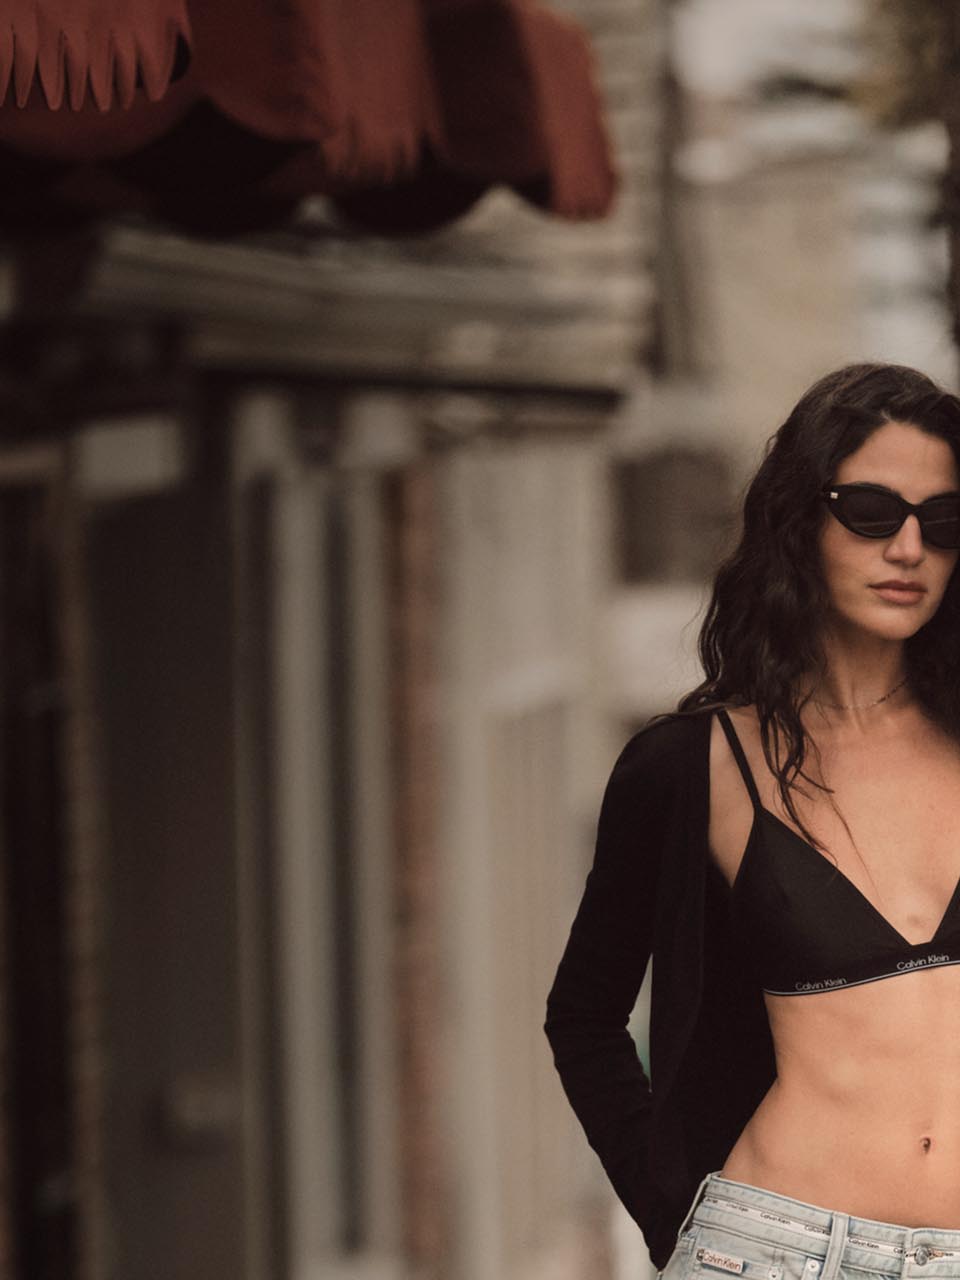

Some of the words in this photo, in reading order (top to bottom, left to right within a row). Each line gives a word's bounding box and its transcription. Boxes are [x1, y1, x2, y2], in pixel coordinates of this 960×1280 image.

[896, 958, 927, 970] Calvin
[927, 954, 950, 964] Klein
[795, 981, 824, 991] Calvin
[824, 977, 847, 987] Klein
[704, 1251, 723, 1264] Calvin
[723, 1257, 741, 1270] Klein
